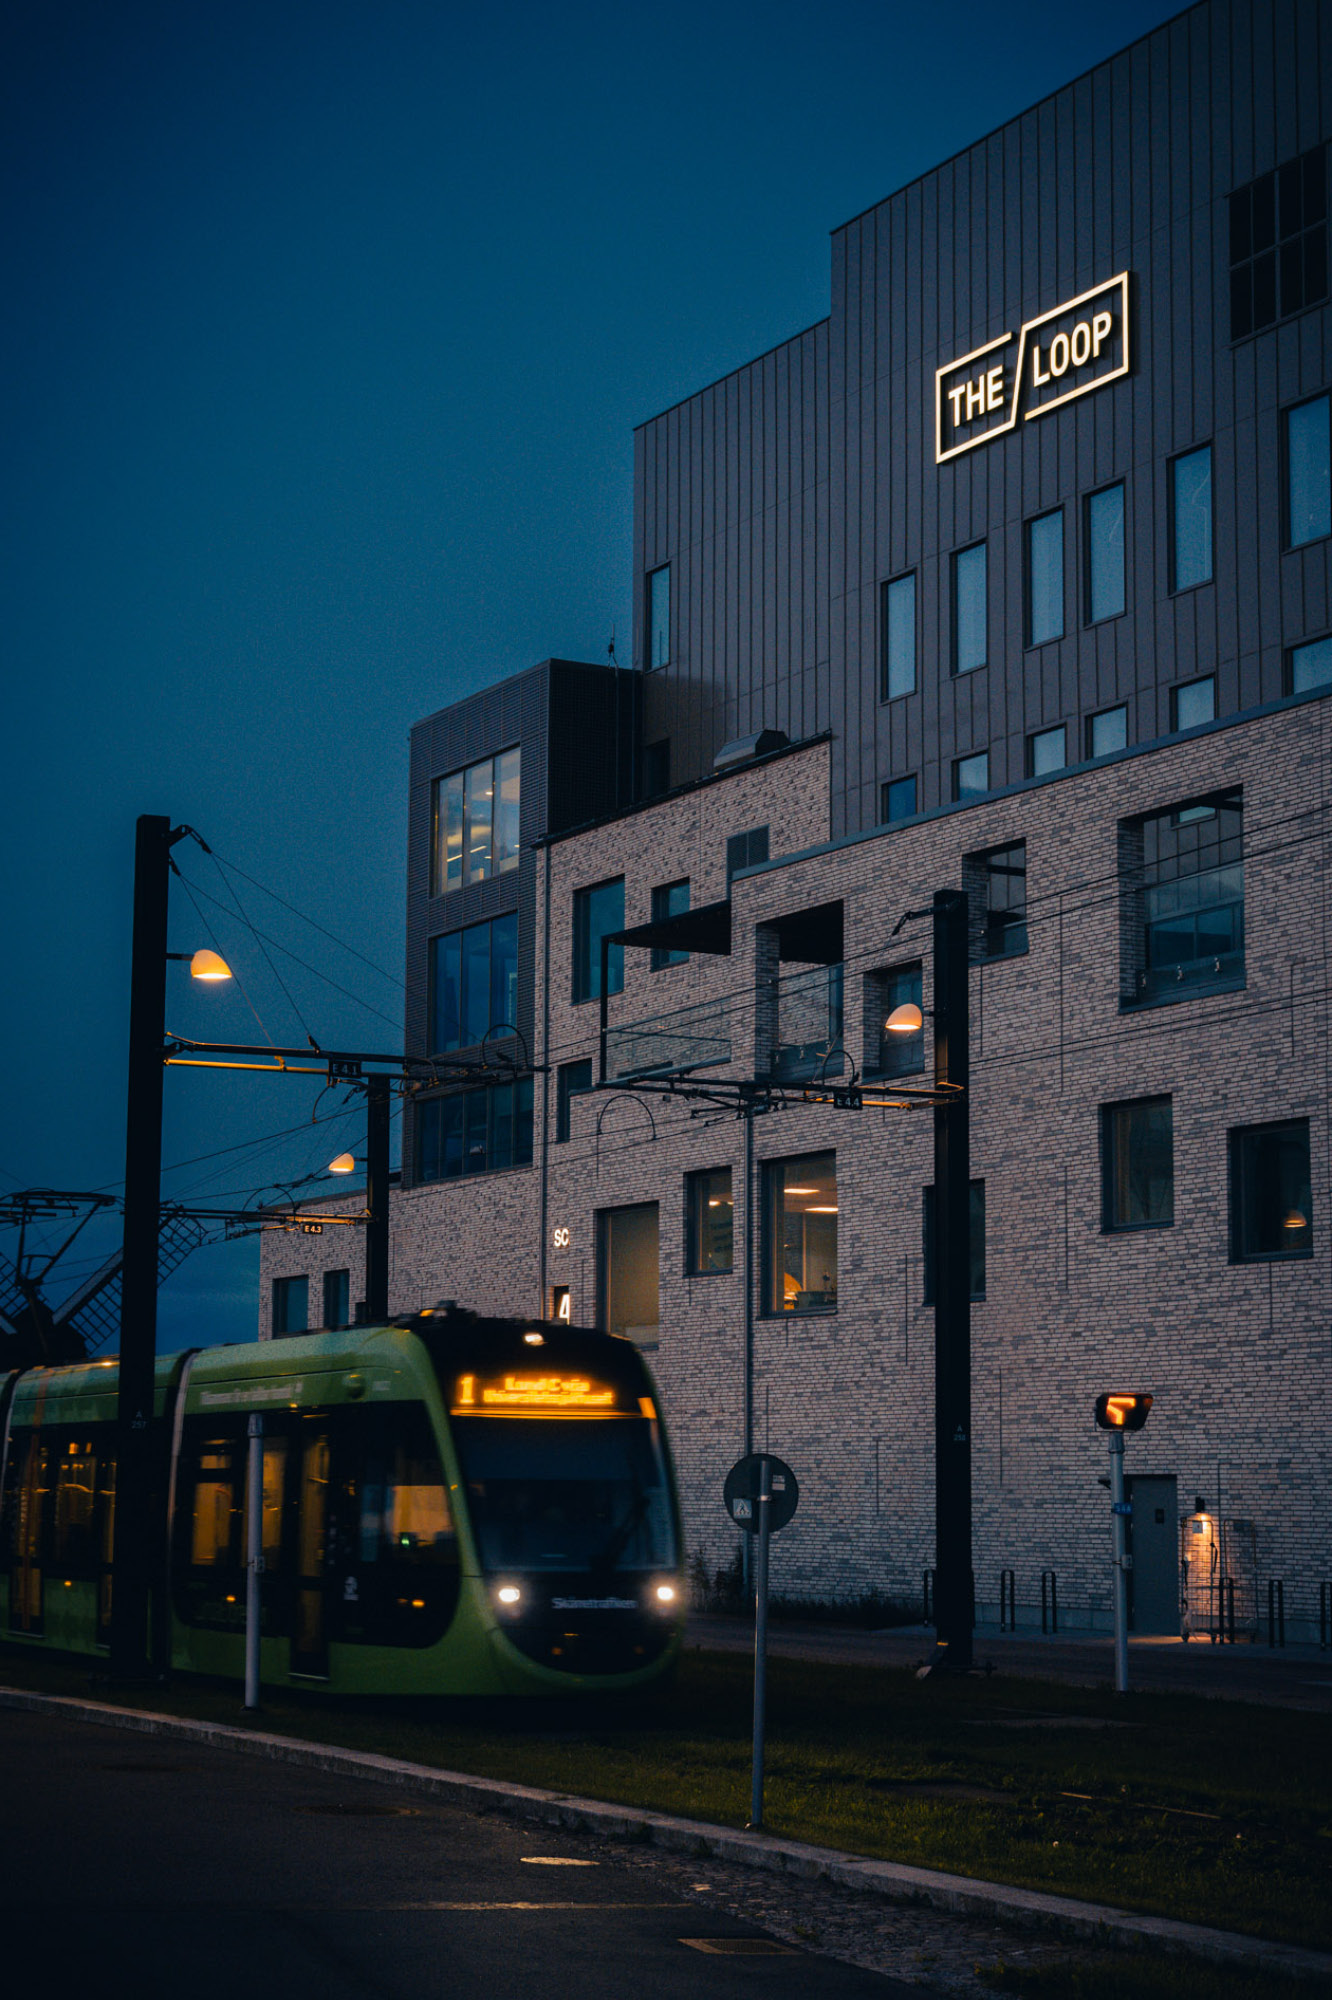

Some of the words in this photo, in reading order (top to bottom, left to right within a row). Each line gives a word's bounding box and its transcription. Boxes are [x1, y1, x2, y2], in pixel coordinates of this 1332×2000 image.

[948, 365, 1004, 428] THE
[1033, 311, 1112, 388] LOOP
[304, 1225, 310, 1233] E
[310, 1225, 322, 1233] 4.3
[554, 1228, 570, 1247] SC
[559, 1293, 571, 1325] 4
[460, 1376, 475, 1404] 1
